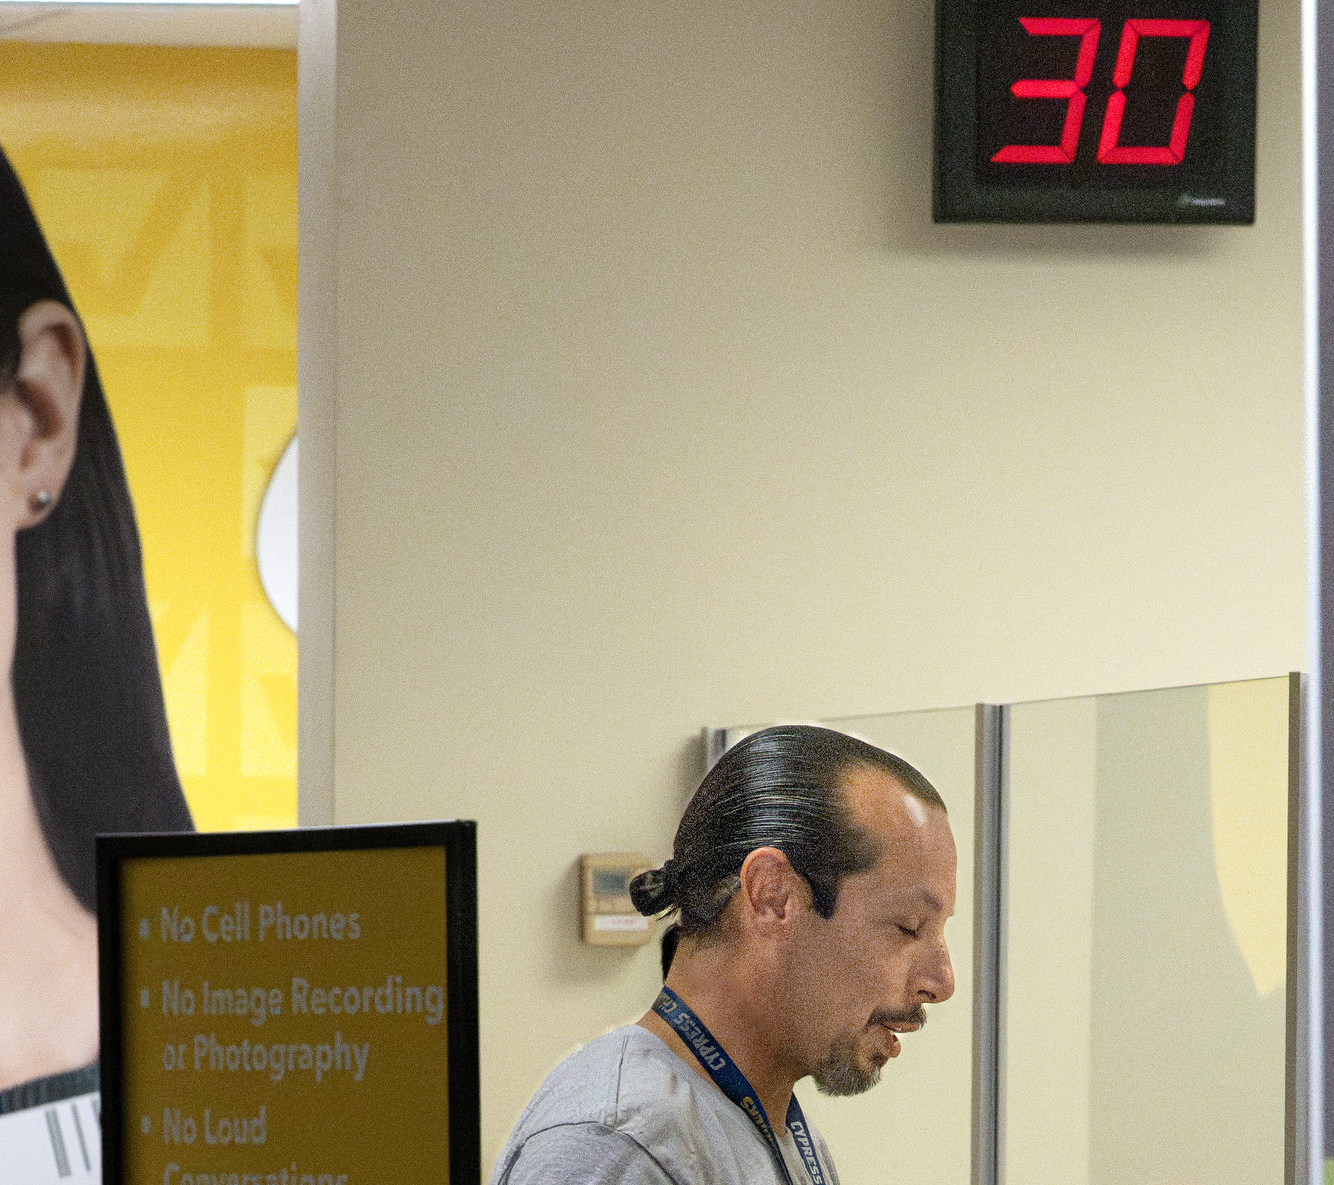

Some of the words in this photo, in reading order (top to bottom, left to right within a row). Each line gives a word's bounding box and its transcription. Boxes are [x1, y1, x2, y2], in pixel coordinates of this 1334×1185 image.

[990, 17, 1210, 164] 30
[161, 906, 194, 942] No
[202, 902, 250, 943] Cell
[258, 901, 362, 941] Phones
[162, 979, 195, 1016] No
[203, 981, 283, 1027] Image
[291, 975, 444, 1026] Recording
[163, 1044, 186, 1071] or
[194, 1032, 369, 1082] Photography
[674, 1011, 726, 1071] CYPRESS
[163, 1107, 196, 1145] No
[204, 1105, 267, 1145] Loud
[790, 1121, 822, 1184] CYPRESS
